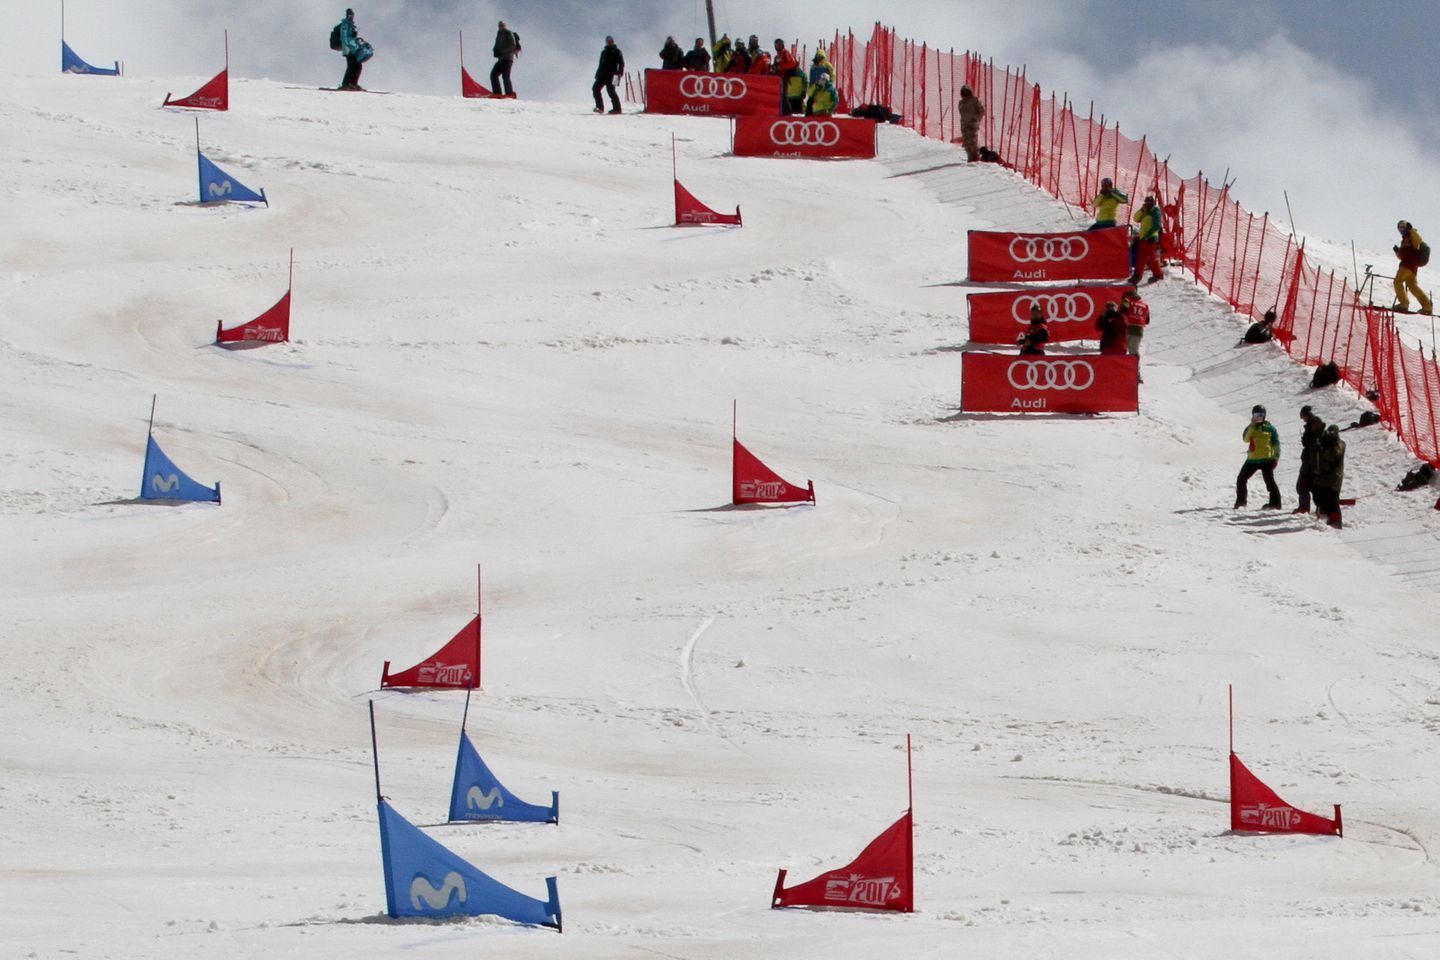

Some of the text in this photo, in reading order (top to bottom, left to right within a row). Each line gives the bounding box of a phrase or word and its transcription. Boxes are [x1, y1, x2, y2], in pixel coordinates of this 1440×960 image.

[681, 103, 710, 112] Audi
[1013, 269, 1046, 279] Audi
[1011, 397, 1046, 408] Audi
